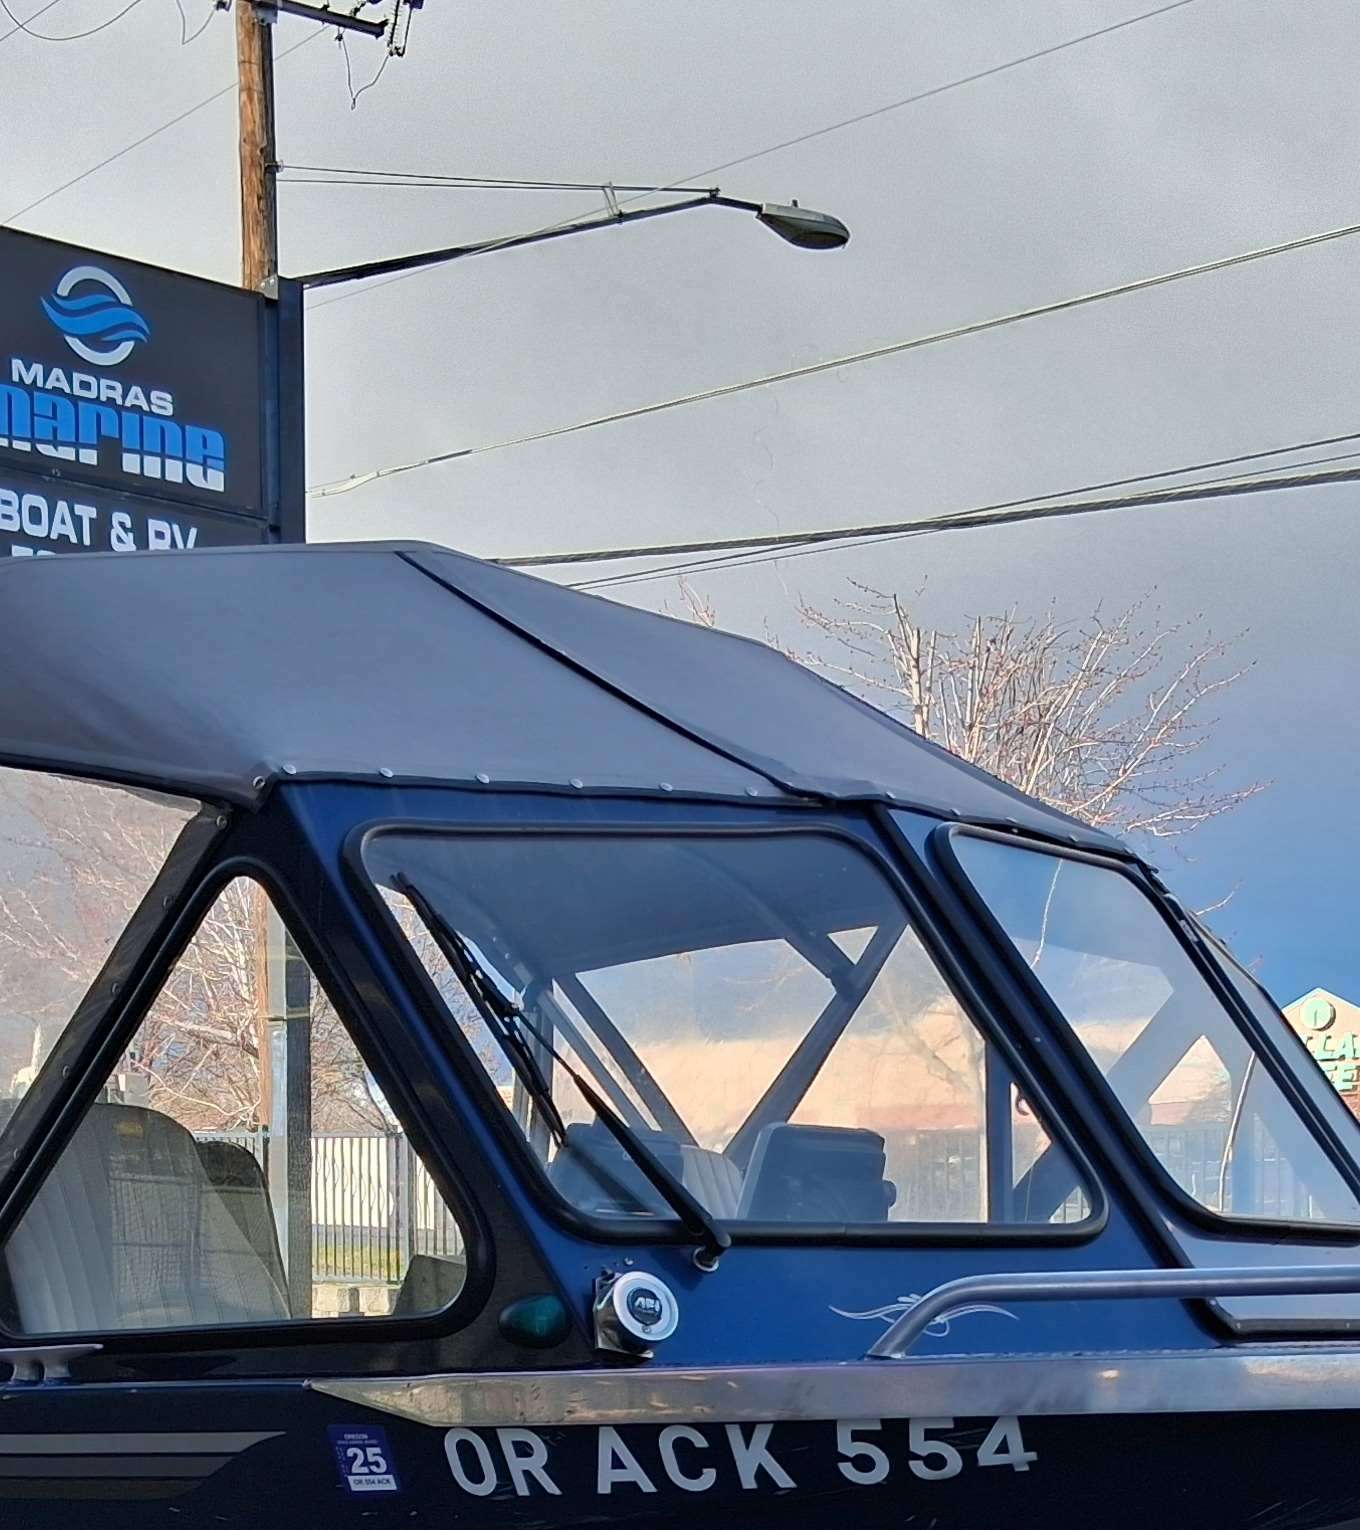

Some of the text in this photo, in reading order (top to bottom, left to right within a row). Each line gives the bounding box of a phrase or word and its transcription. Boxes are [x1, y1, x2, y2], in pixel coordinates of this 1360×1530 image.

[11, 358, 173, 416] MADRAS
[110, 511, 136, 552] &
[347, 1447, 387, 1473] 25
[444, 1417, 1038, 1496] OR ACK 554
